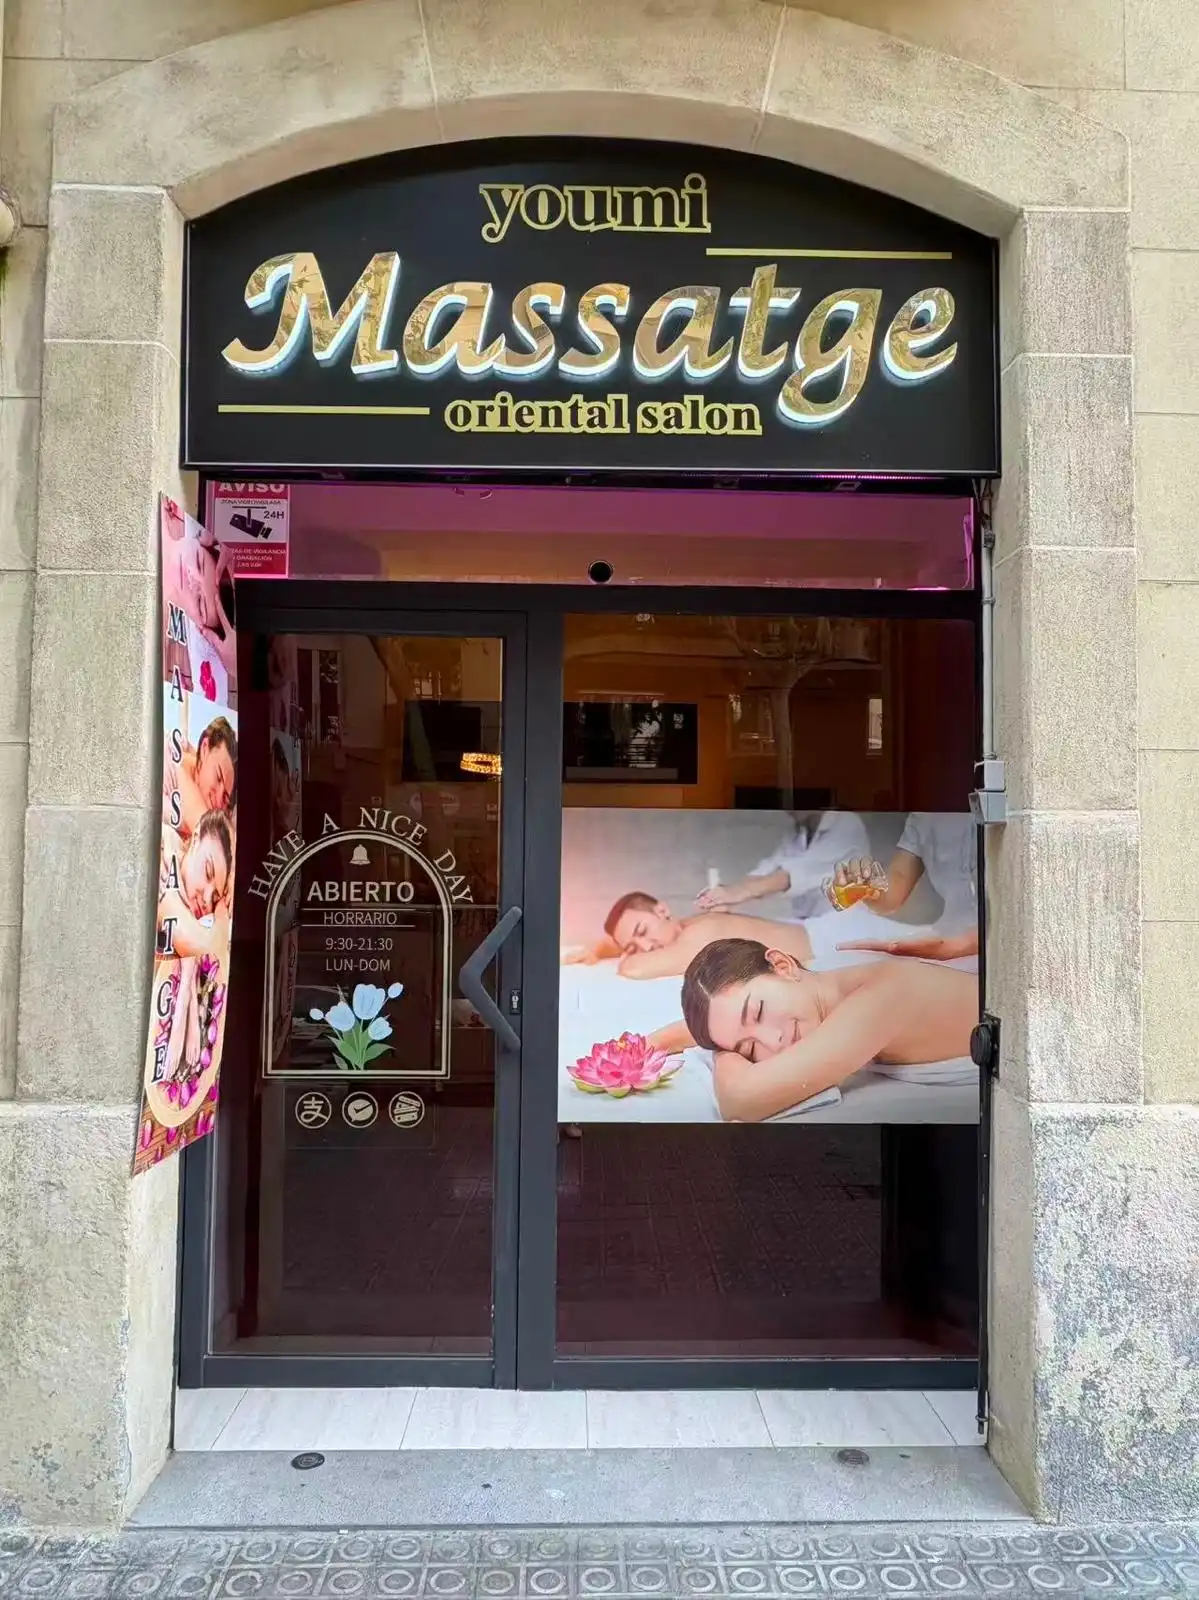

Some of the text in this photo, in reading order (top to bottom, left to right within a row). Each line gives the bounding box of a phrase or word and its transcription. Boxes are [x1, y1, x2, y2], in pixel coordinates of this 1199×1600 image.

[480, 173, 711, 243] youmi
[221, 250, 958, 425] Massatge
[444, 391, 763, 436] oriental salon
[264, 511, 285, 519] 24H
[151, 602, 187, 1084] MASSATGE
[248, 806, 474, 904] HAVE A NICE DAY
[306, 880, 415, 903] ABIERTO
[323, 911, 398, 925] HORRARIO
[325, 937, 394, 951] 9:30-21:30
[325, 958, 391, 972] LUN-DOM
